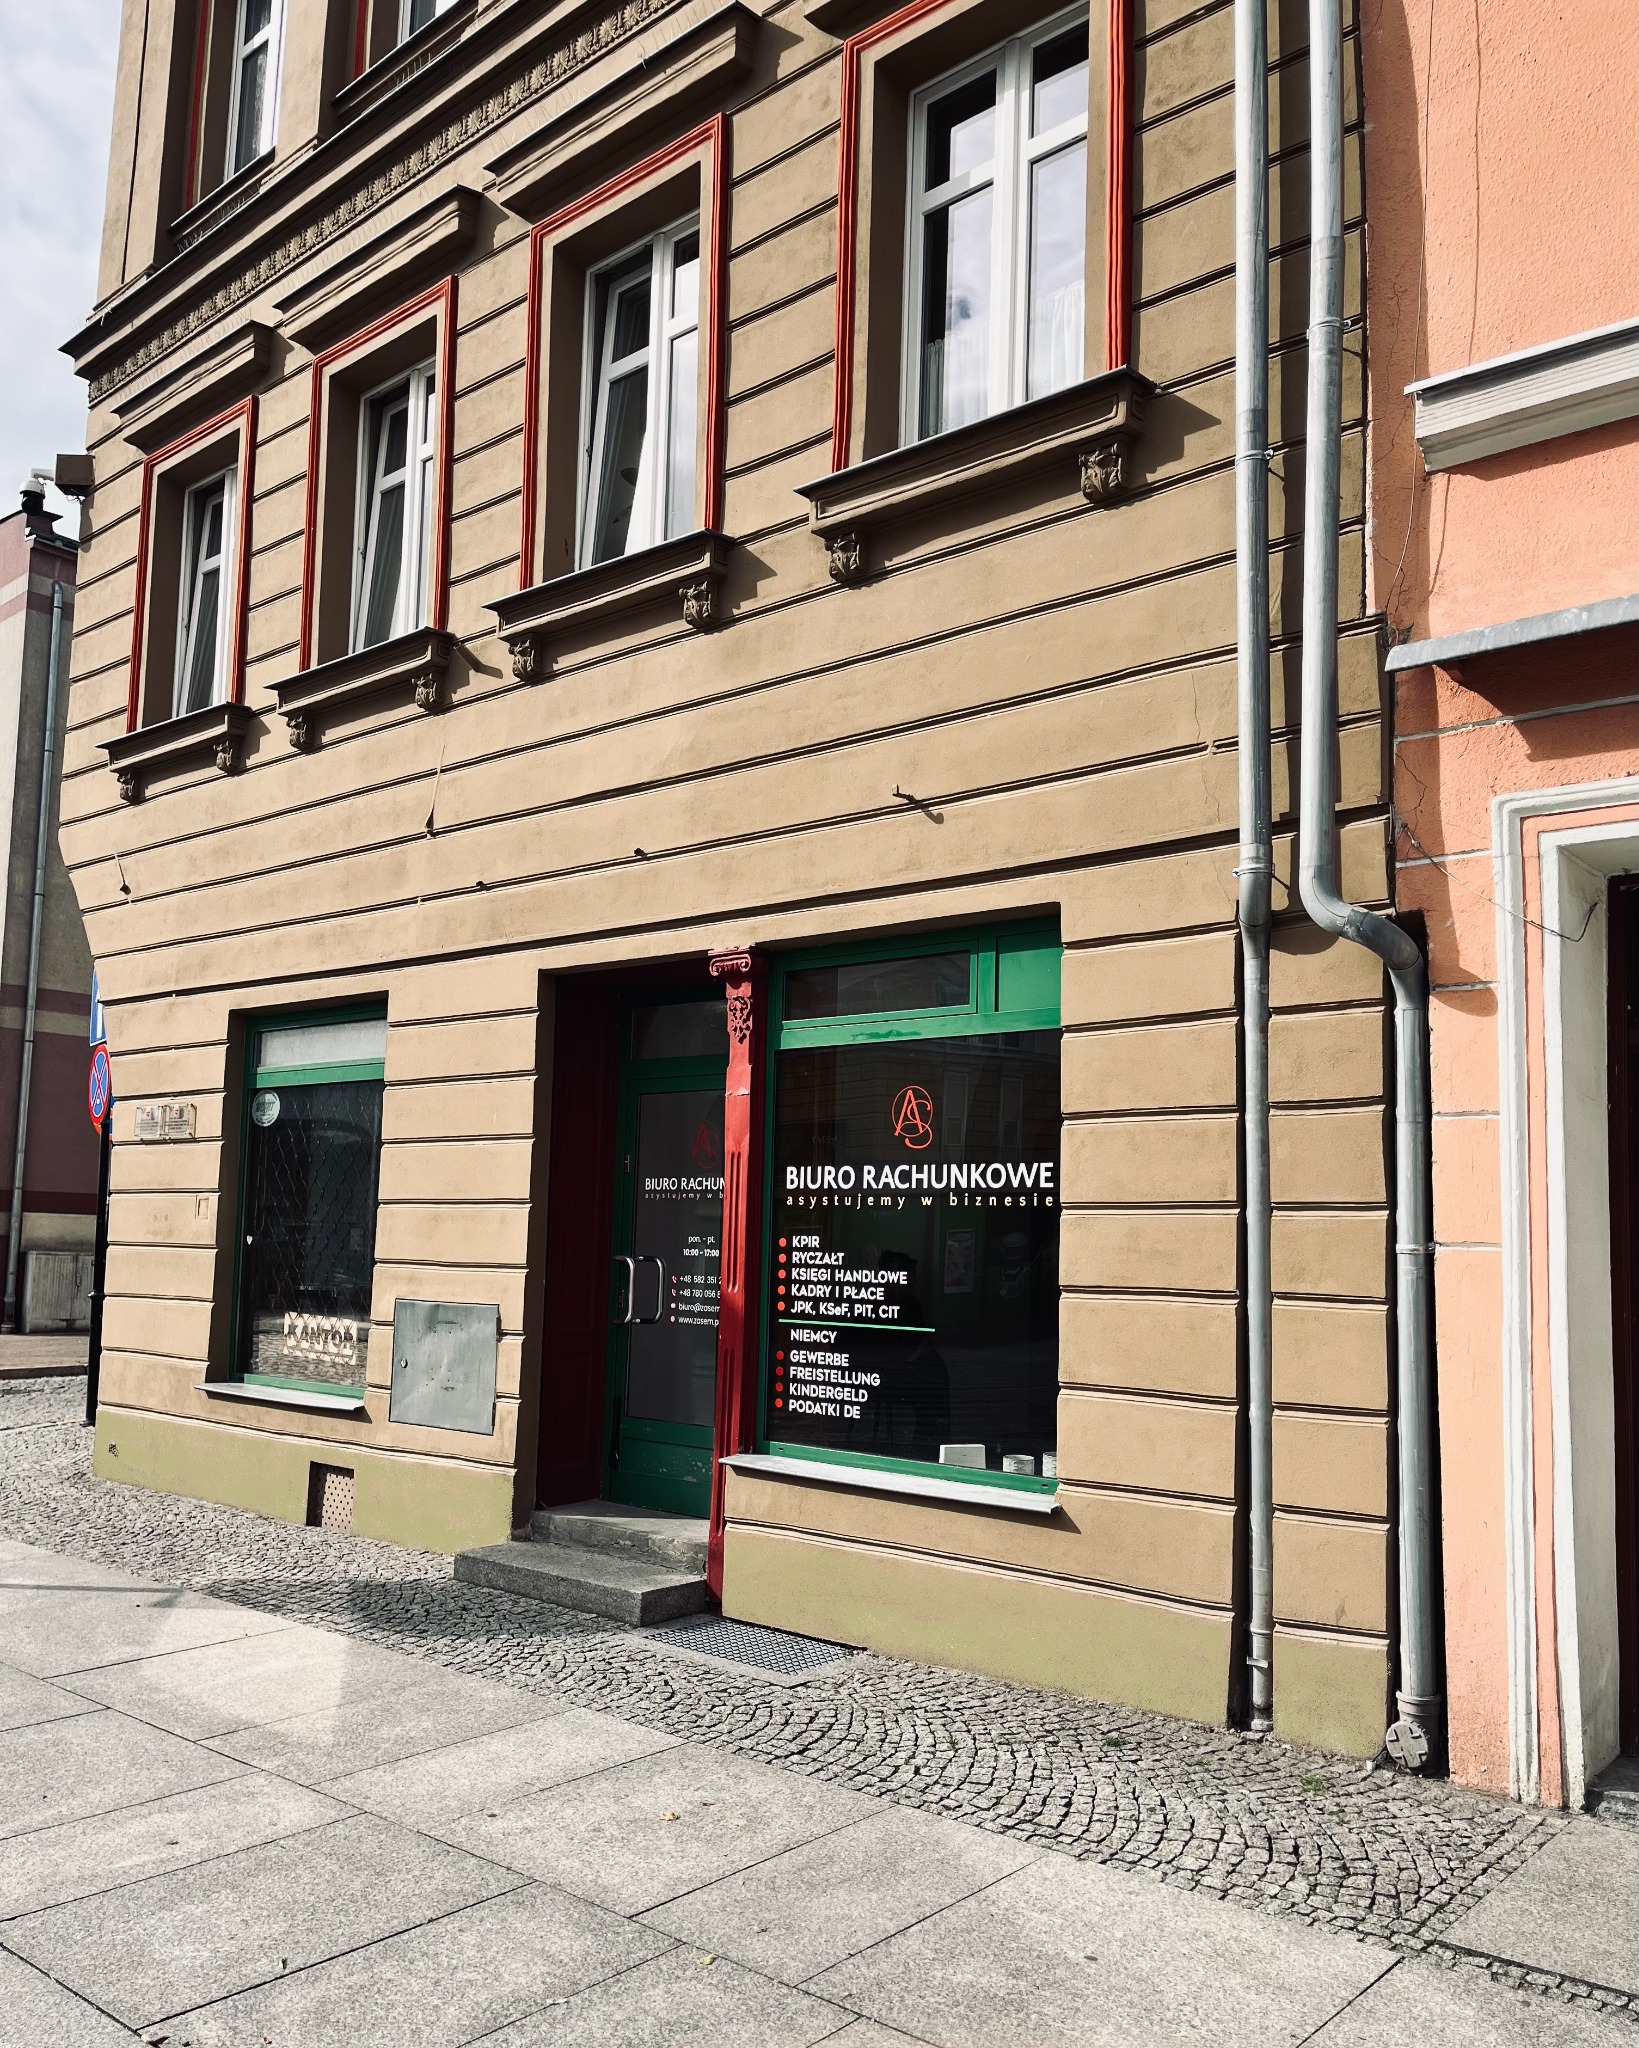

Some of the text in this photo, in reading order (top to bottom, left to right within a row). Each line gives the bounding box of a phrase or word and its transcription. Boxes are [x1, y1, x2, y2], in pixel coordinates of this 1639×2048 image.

[645, 1178, 678, 1191] BIURO
[785, 1161, 1054, 1190] BIURO RACHUNKOWE
[786, 1191, 1054, 1210] asystujemy w biznesie
[792, 1235, 820, 1249] KPIR
[791, 1251, 845, 1266] RYCZAŁT
[791, 1267, 908, 1285] KSIĘGI HANDLOWE
[791, 1283, 885, 1301] KADRY I PŁACE
[790, 1301, 900, 1319] JPK, KSeF, PIT, CIT
[790, 1328, 837, 1344] NIEMCY
[789, 1349, 850, 1367] GEWERBE
[789, 1366, 881, 1387] FREISTELLUNG
[789, 1382, 868, 1403] KINDERGELD
[788, 1399, 861, 1419] PODATKI DE
